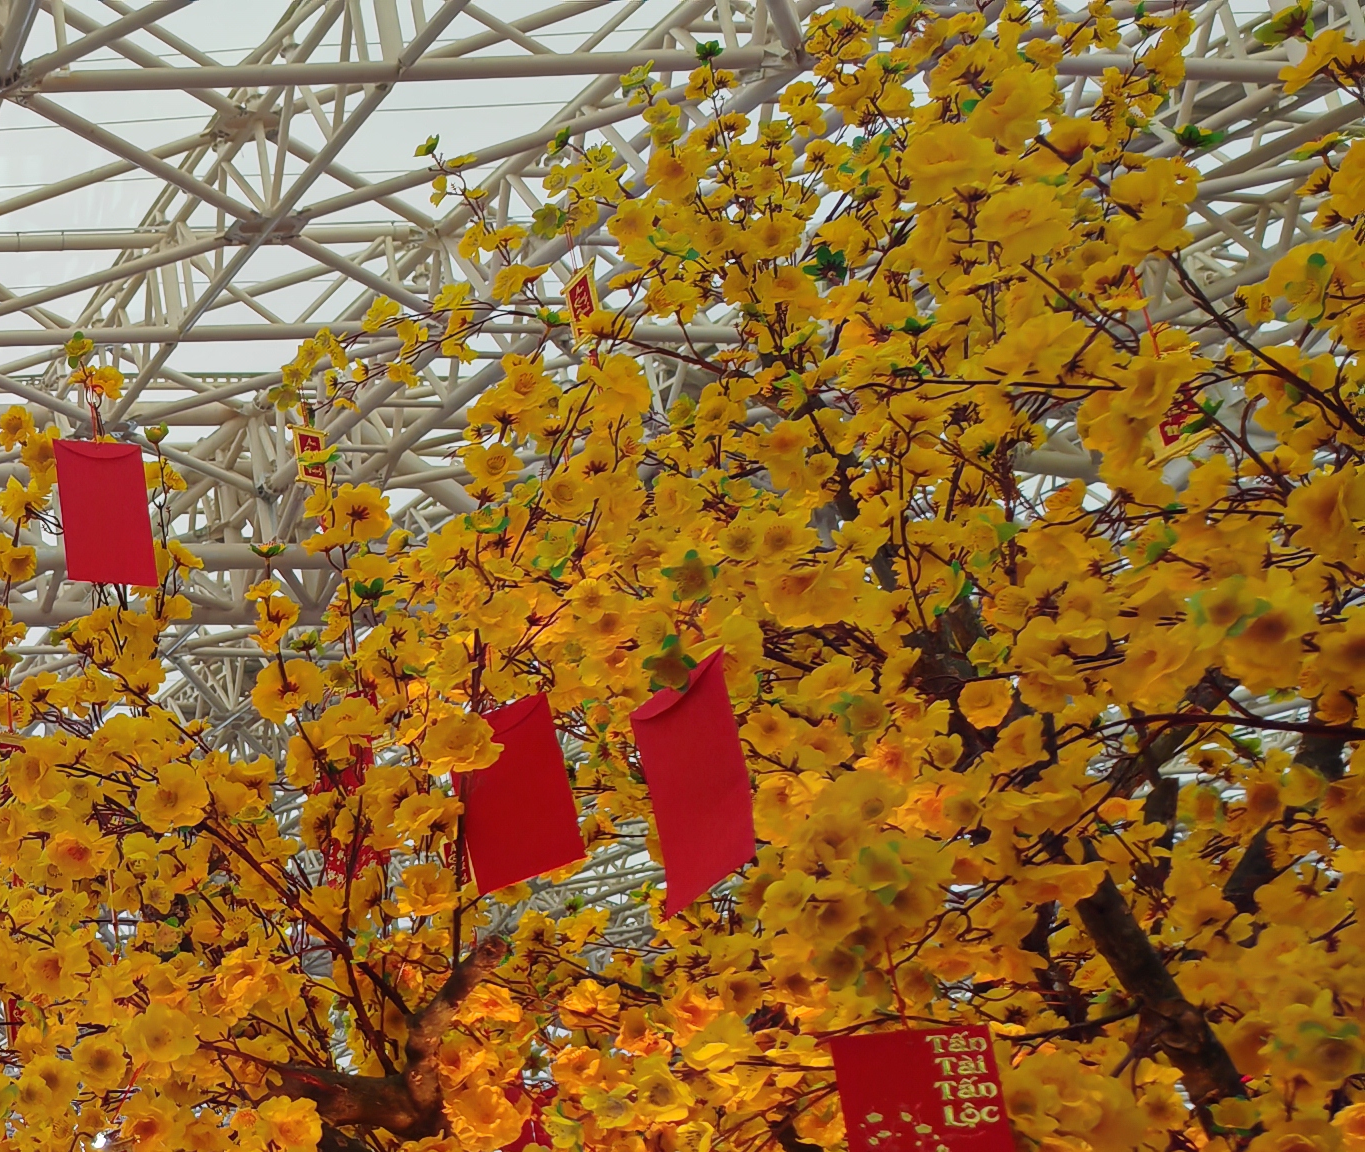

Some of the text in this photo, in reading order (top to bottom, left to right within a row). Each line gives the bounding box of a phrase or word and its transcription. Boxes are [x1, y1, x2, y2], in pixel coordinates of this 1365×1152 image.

[925, 1031, 988, 1053] Tấn
[934, 1055, 988, 1075] Tài
[933, 1076, 998, 1100] Tấn
[943, 1102, 1000, 1128] Lộc
